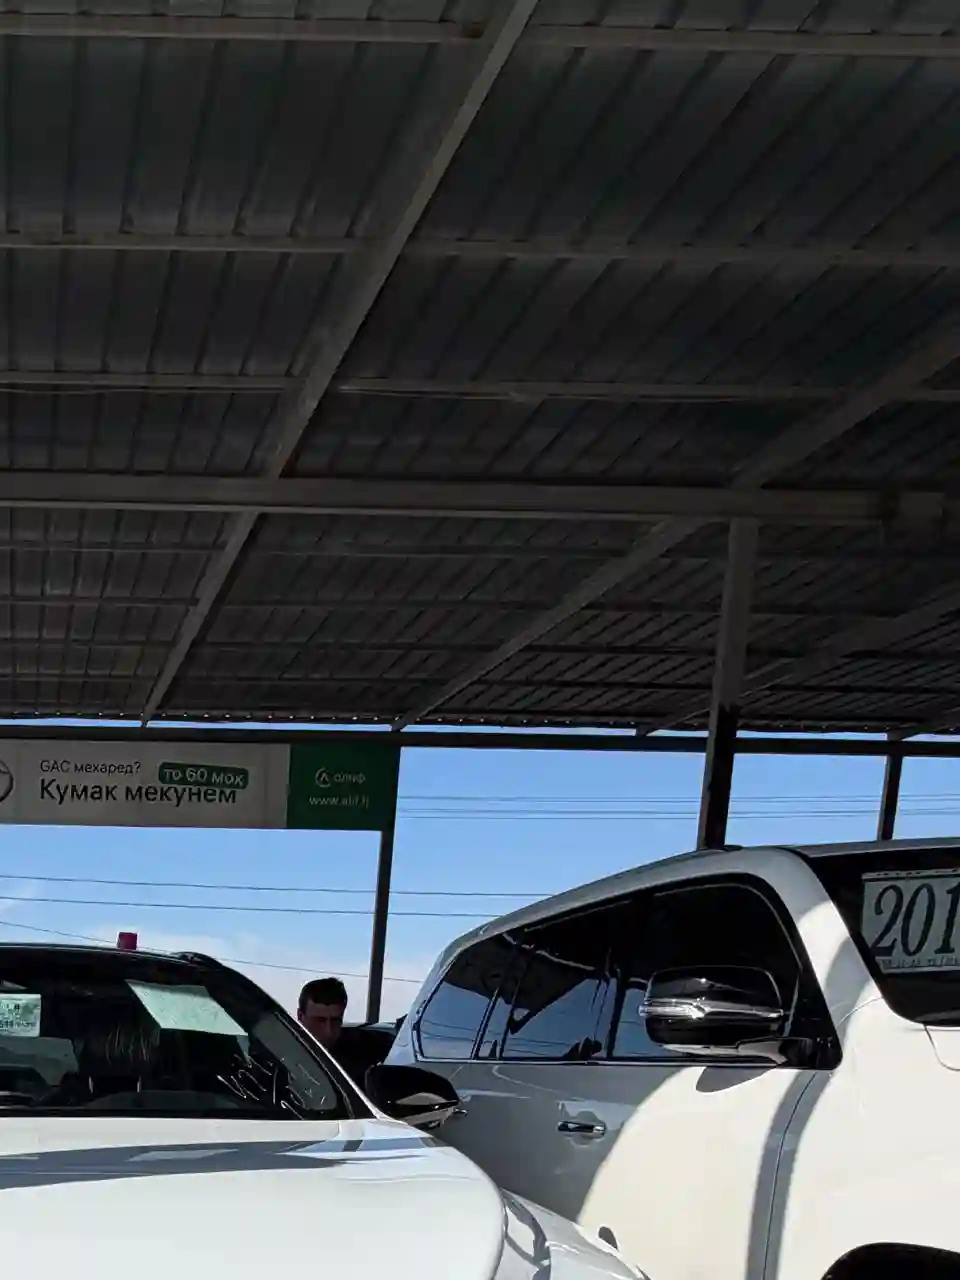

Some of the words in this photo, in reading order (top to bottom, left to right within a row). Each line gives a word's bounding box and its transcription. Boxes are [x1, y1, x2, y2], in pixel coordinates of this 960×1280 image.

[40, 760, 71, 773] GAC
[74, 761, 141, 776] мехаред?
[185, 767, 208, 782] 60
[40, 778, 118, 806] Кумак
[125, 784, 237, 808] мекунем
